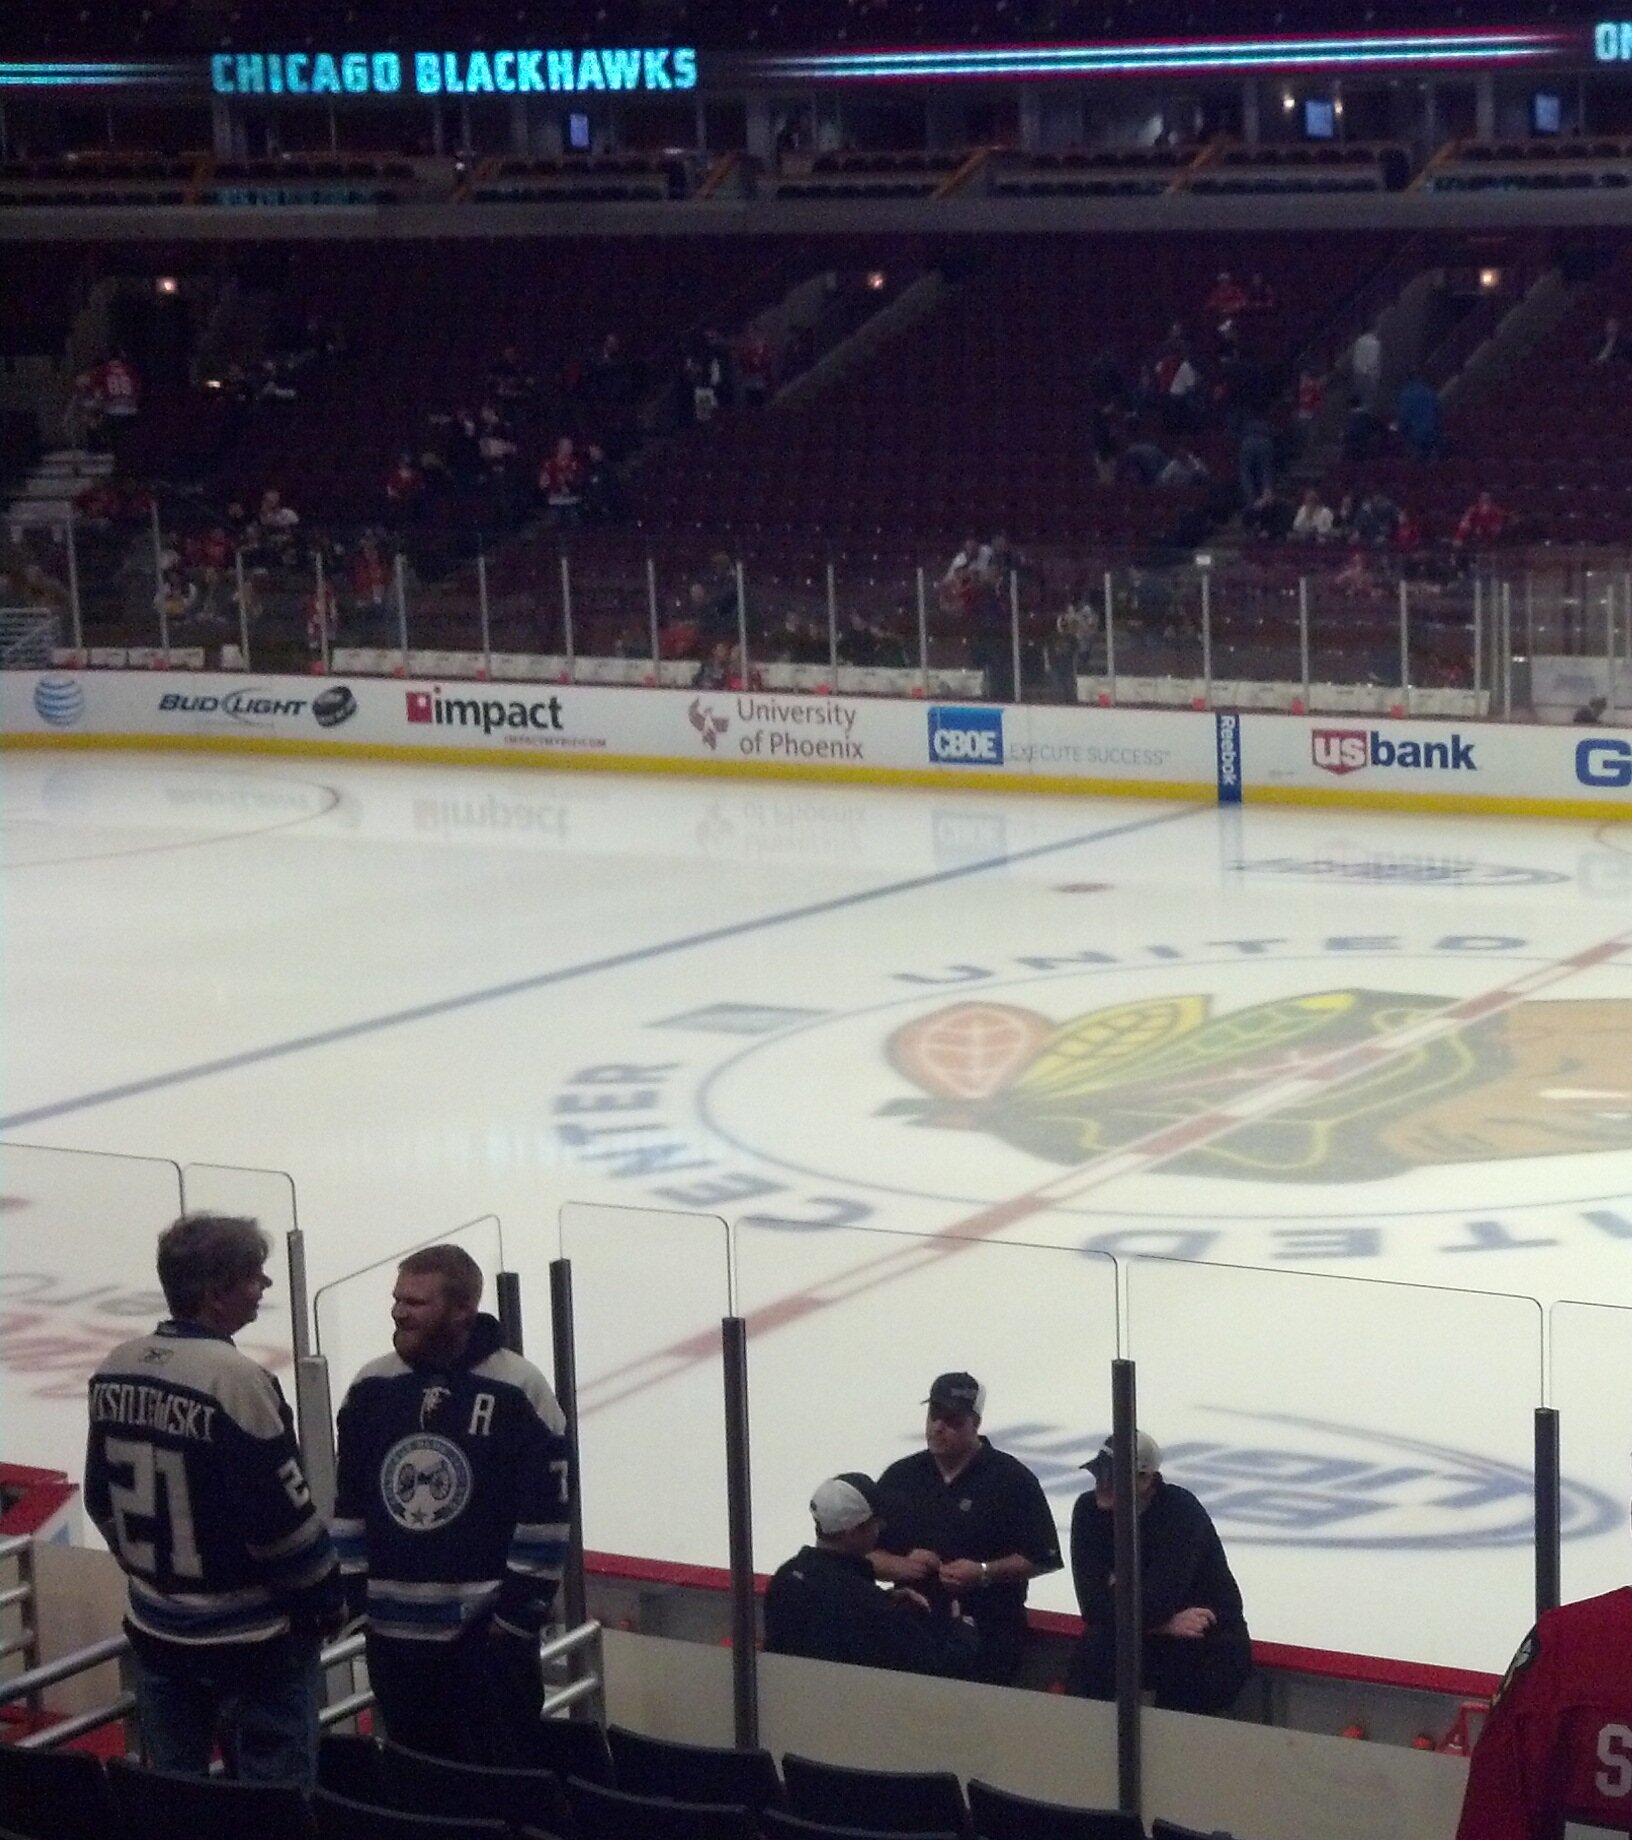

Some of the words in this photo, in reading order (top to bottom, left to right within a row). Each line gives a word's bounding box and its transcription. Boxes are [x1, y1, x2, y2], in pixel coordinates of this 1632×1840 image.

[211, 53, 400, 93] CHICAGO
[414, 49, 697, 93] BLACKHAWKS
[159, 693, 218, 711] BUD
[231, 697, 307, 715] LIGHT
[434, 686, 564, 734] impact
[737, 698, 856, 731] University
[739, 730, 763, 755] of
[770, 732, 863, 759] Phoenix
[933, 729, 997, 758] CBOE
[1010, 744, 1082, 763] EXECUTE
[1220, 715, 1236, 786] Reebok
[890, 934, 1527, 985] UNITED
[551, 1062, 875, 1233] CENTER
[468, 1393, 495, 1436] A
[104, 1436, 204, 1579] 21
